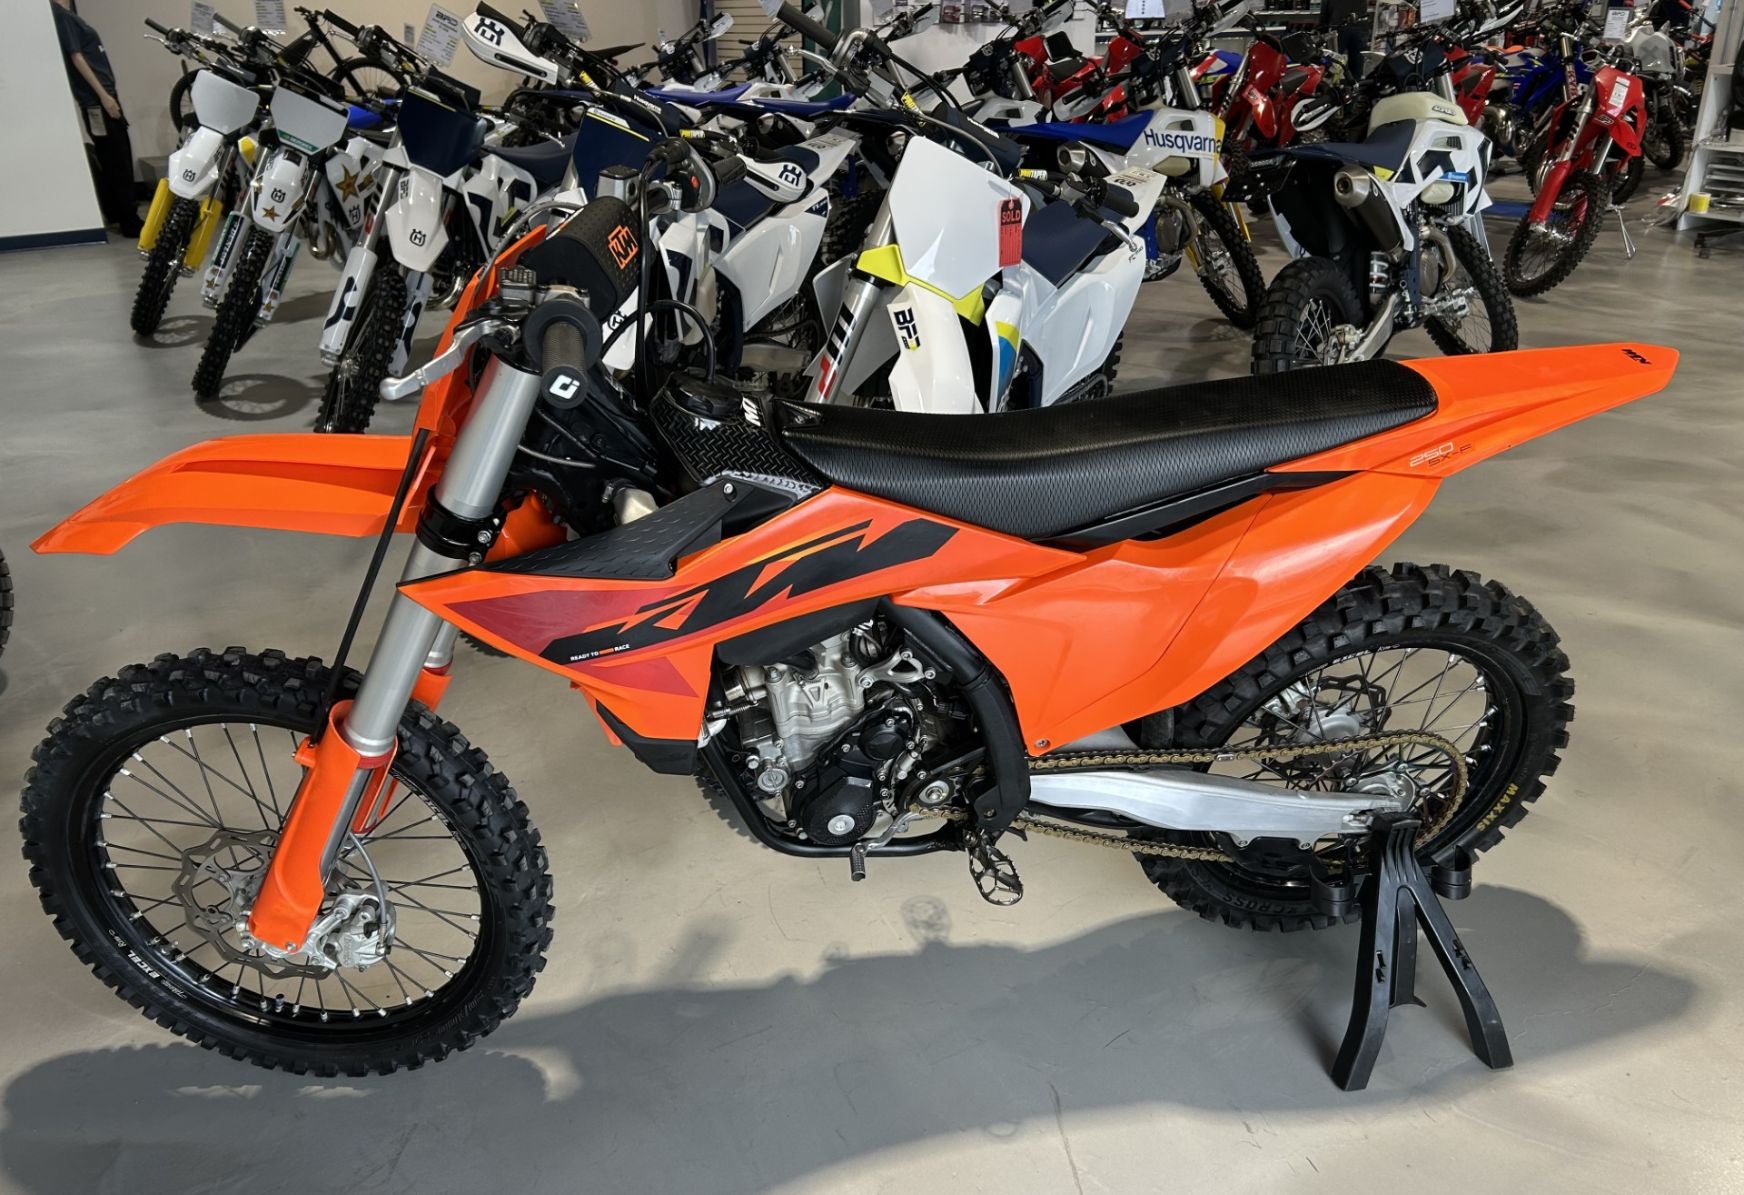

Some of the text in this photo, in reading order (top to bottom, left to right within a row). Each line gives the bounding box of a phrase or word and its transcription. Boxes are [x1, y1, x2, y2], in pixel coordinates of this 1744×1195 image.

[1143, 128, 1222, 154] Husqvarna
[1002, 210, 1021, 223] SOLD
[608, 225, 639, 270] KTM
[1409, 441, 1454, 468] 250
[1428, 443, 1472, 467] SX-F
[540, 517, 961, 667] KTM
[570, 653, 590, 661] READY
[614, 643, 630, 652] RACE
[1476, 783, 1519, 832] MAXXIS
[127, 949, 161, 979] EXCEL
